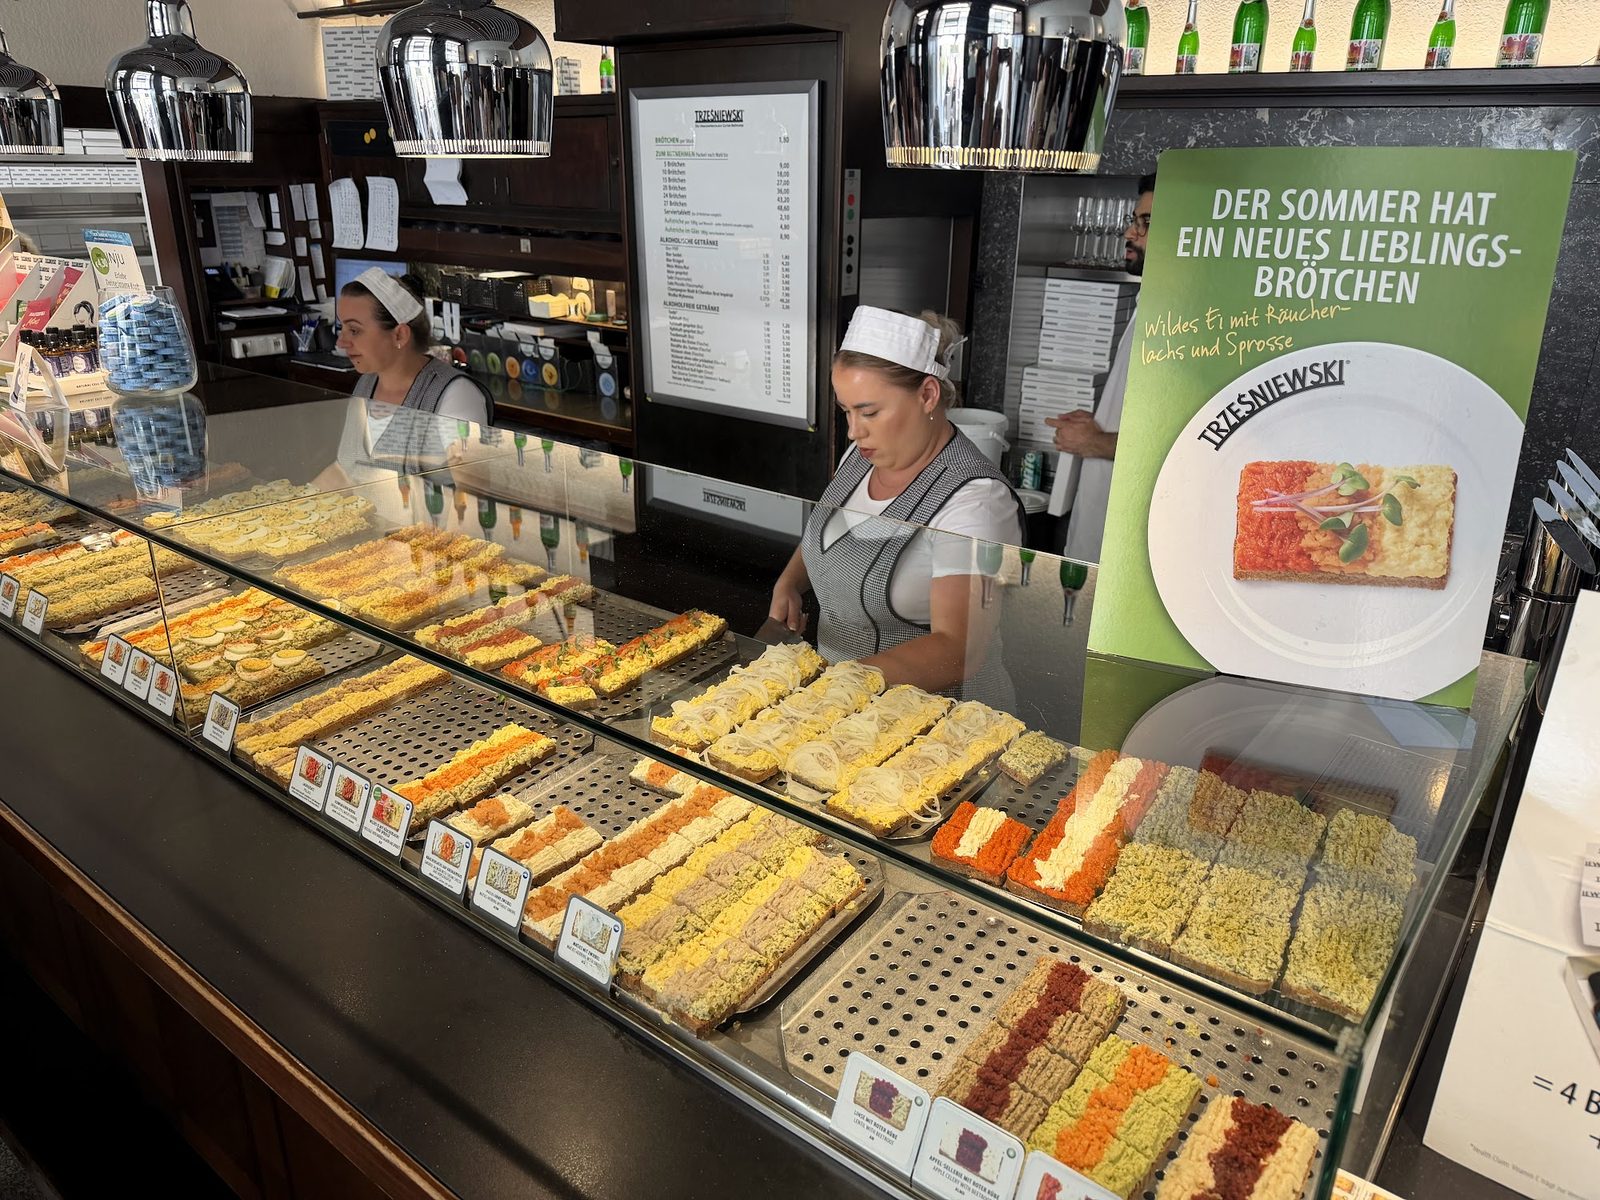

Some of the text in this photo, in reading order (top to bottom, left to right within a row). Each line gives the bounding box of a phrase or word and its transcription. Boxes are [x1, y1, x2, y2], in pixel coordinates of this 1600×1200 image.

[1212, 188, 1496, 226] DER SOMMER HAT
[1176, 226, 1522, 268] EIN NEUES LIEBLINGS-
[1254, 260, 1421, 304] BRÖTCHEN
[1144, 298, 1352, 340] Wildes Ei mit Räucher-
[1141, 331, 1294, 366] lachs und Sprosse
[1196, 359, 1346, 452] TRZEŚNIEWSKI
[1560, 1082, 1578, 1106] 4
[866, 1117, 874, 1125] MIT
[874, 1122, 886, 1132] ROTER
[929, 1155, 963, 1178] APFEL-SELLERIE
[963, 1174, 972, 1184] MIT
[972, 1179, 987, 1192] ROTER
